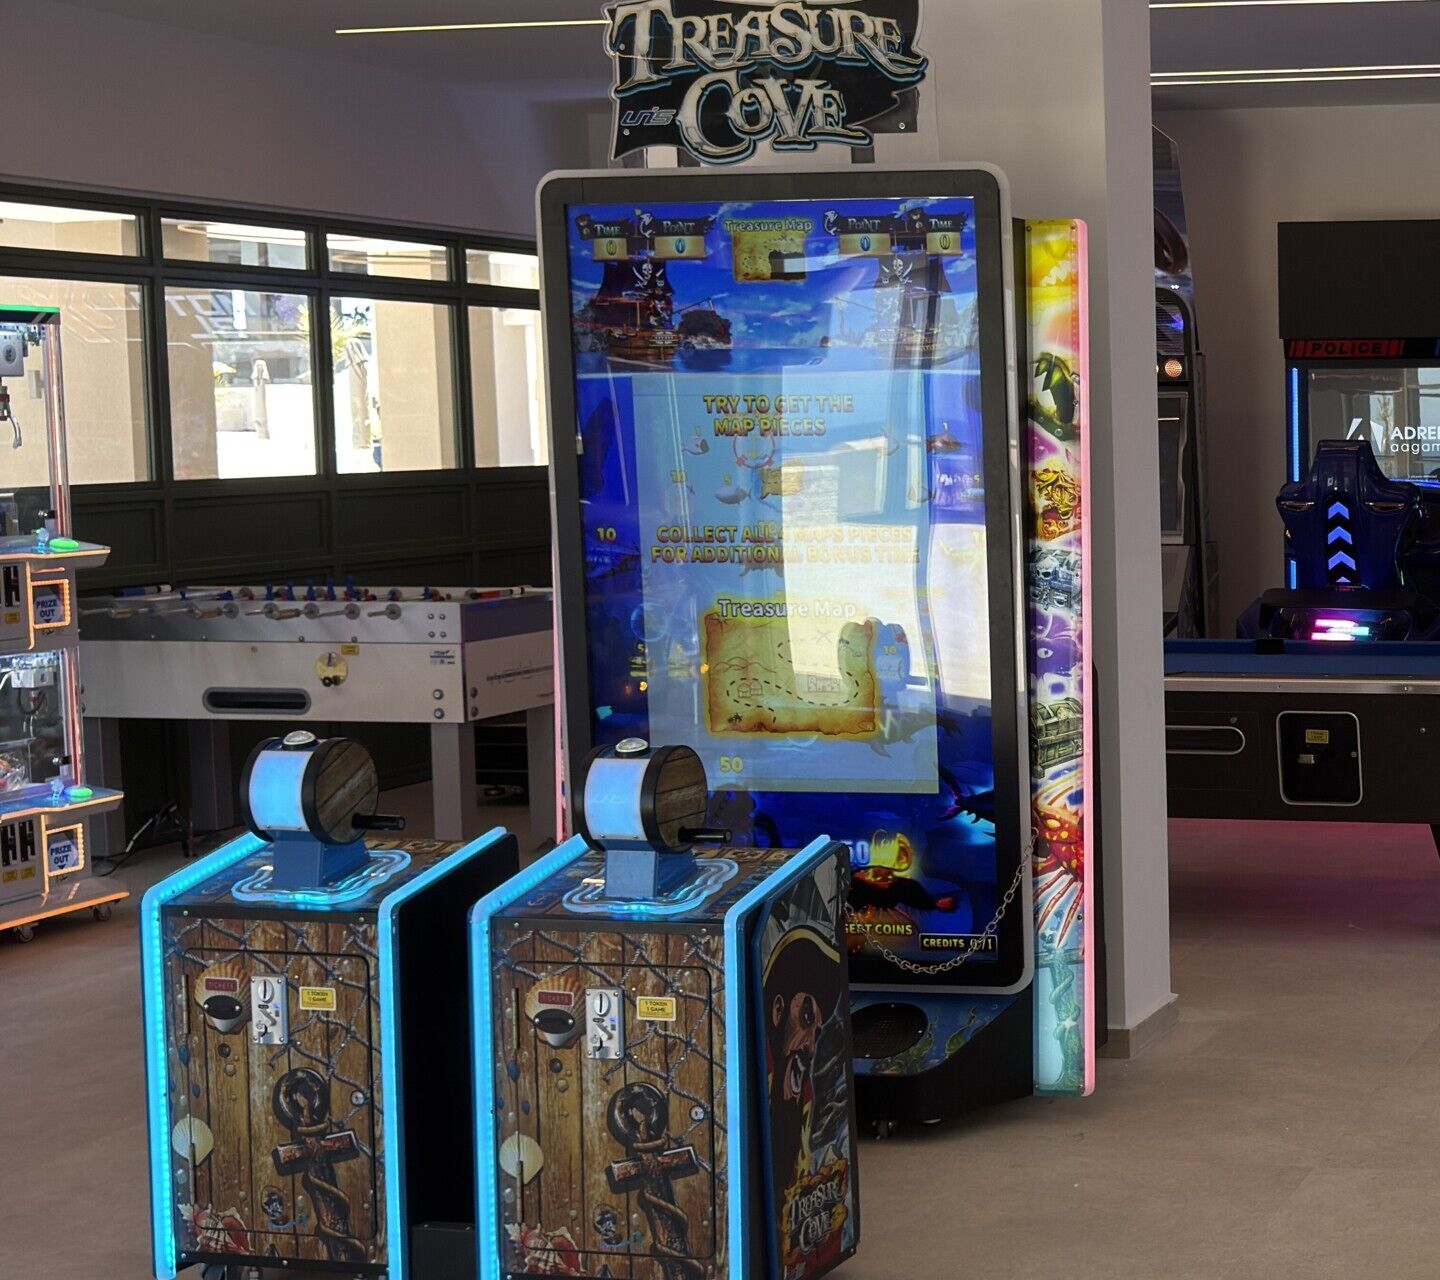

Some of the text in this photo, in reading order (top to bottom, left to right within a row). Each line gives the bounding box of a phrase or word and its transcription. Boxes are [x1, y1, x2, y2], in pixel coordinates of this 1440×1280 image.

[675, 71, 873, 164] COVE
[724, 219, 813, 234] Treasure Map
[1311, 341, 1383, 355] POLICE
[704, 394, 854, 414] TRY TO GET THE
[714, 417, 826, 437] MAP PIECES
[656, 526, 740, 544] COLLECT
[742, 526, 774, 543] ALL
[793, 526, 844, 543] MAPS
[847, 526, 914, 543] PIECES
[651, 546, 920, 564] FOR ADDITIONAL BONUS TIME
[36, 599, 57, 609] PRIZE
[718, 598, 857, 623] Treasure Map
[40, 609, 55, 618] OUT
[719, 756, 744, 772] 50
[50, 844, 72, 856] PRIZE
[54, 854, 70, 865] OUT
[875, 924, 913, 935] COINS
[923, 938, 965, 948] CREDITS
